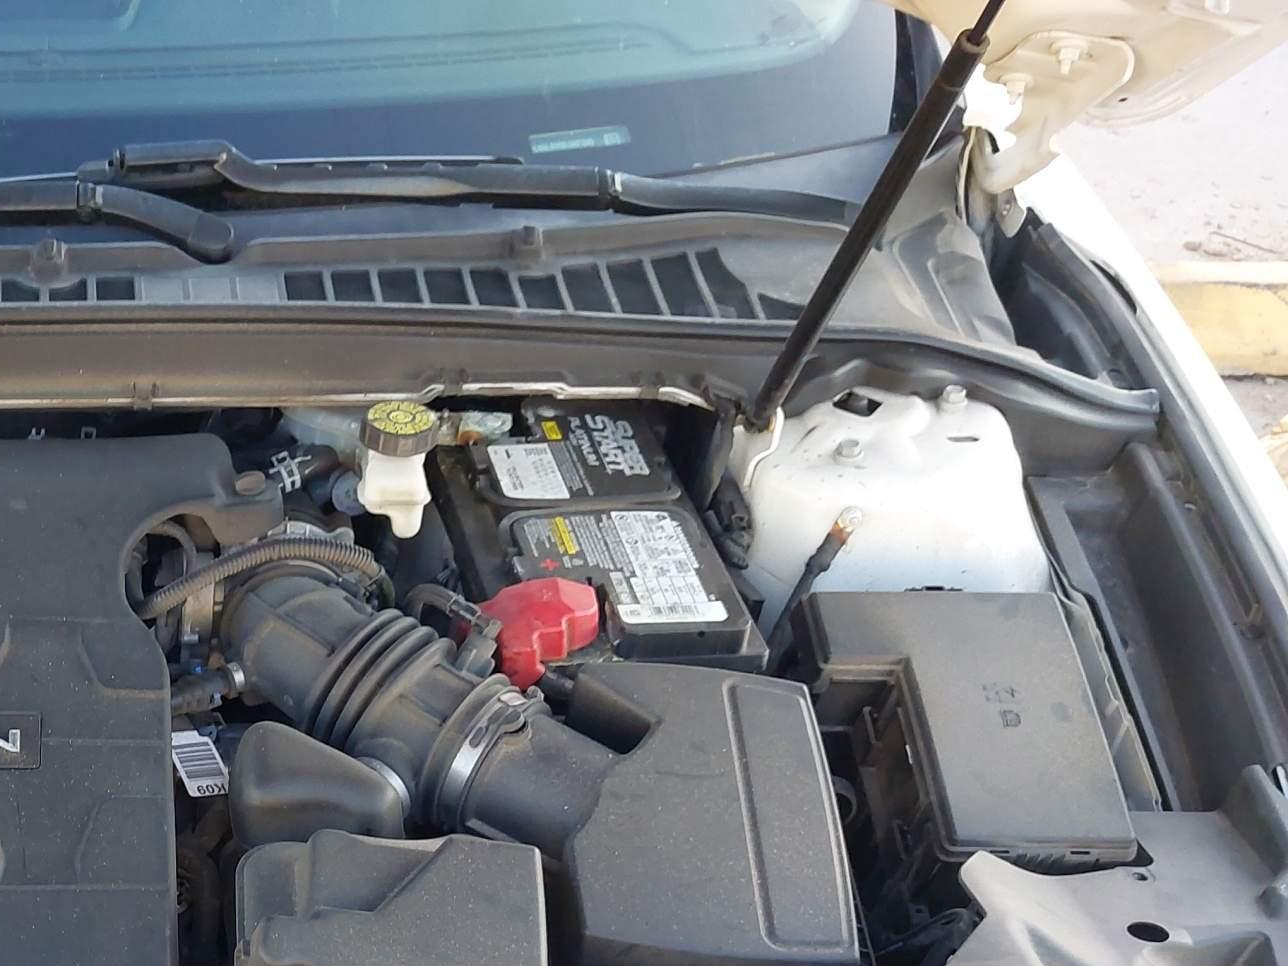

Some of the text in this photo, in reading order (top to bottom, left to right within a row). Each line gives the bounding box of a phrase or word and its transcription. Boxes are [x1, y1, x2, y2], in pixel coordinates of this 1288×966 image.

[567, 416, 600, 467] PLATINUM
[584, 413, 626, 473] START
[614, 420, 651, 477] SUPER
[196, 783, 228, 796] K09
